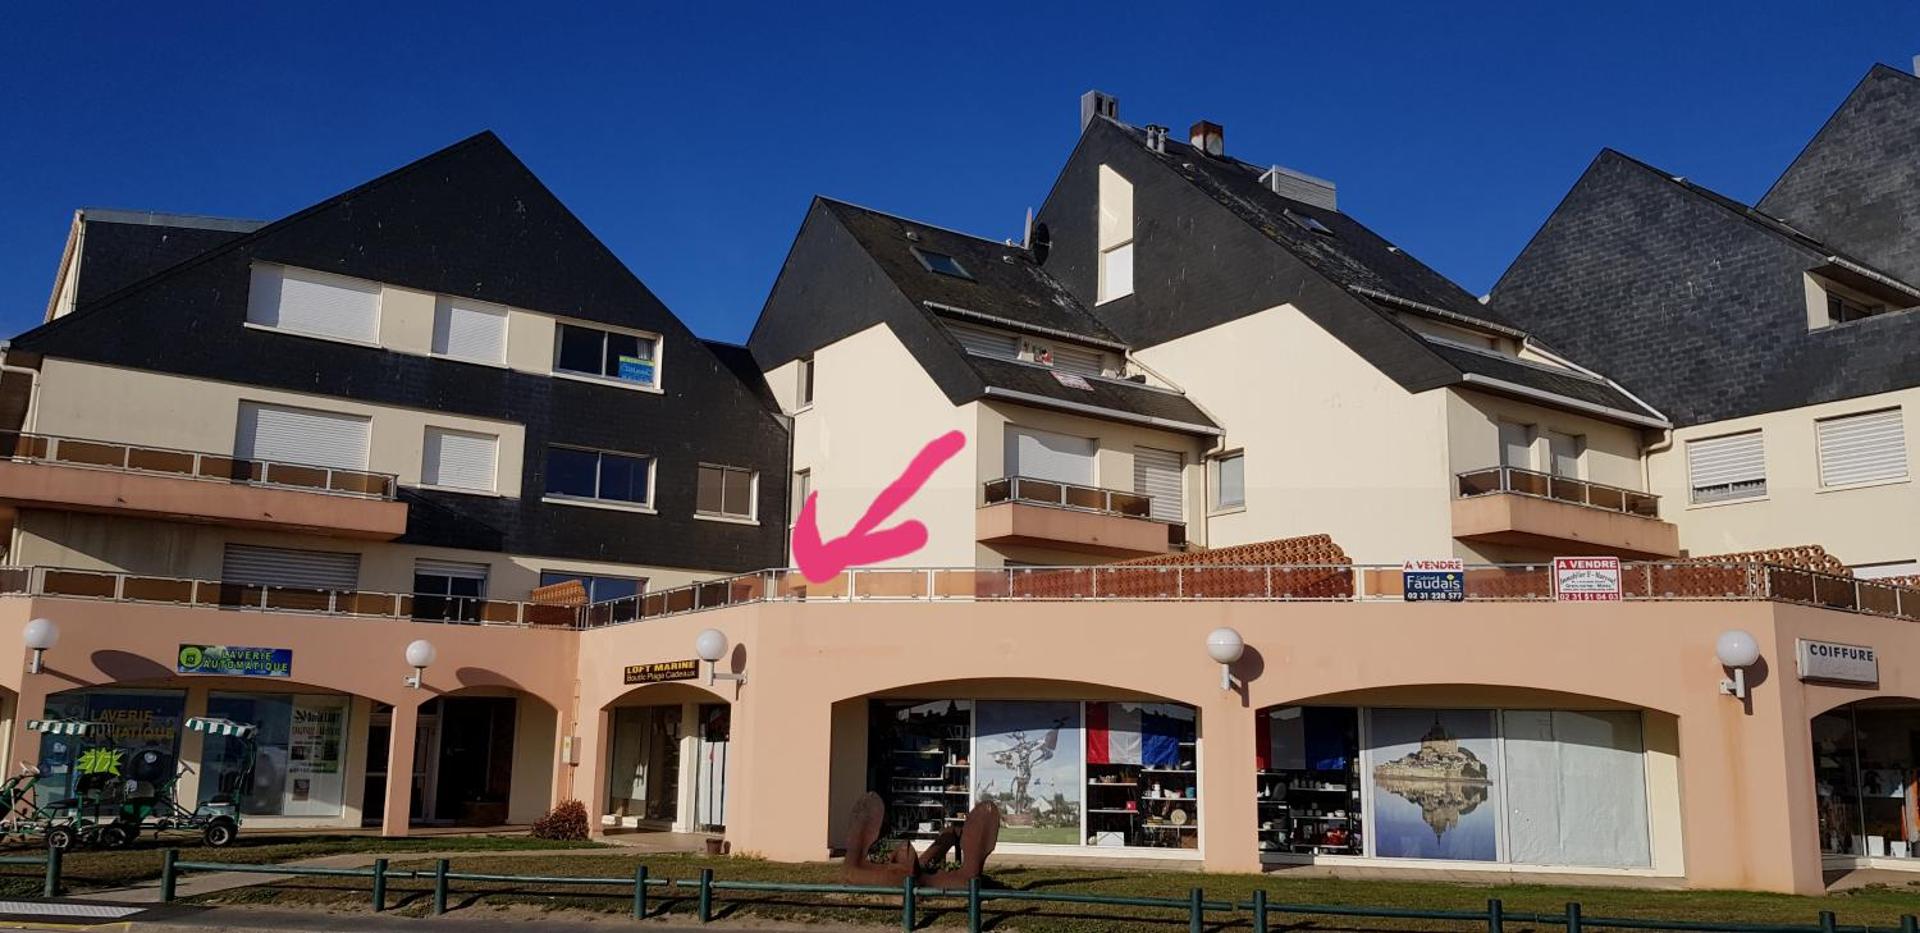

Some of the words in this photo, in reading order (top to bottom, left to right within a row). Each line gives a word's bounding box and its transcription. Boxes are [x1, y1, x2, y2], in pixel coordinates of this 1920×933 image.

[1404, 560, 1413, 570] A
[1416, 560, 1462, 570] VENDRE
[1558, 560, 1567, 569] A
[1569, 560, 1617, 569] VENDRE
[1407, 575, 1461, 590] Faudais
[1407, 592, 1418, 600] 02
[1419, 592, 1429, 600] 31
[1430, 592, 1446, 600] 228
[1448, 592, 1463, 600] 577
[221, 649, 273, 661] LAVERIE
[1809, 644, 1874, 662] COIFFURE
[203, 659, 289, 672] AUTOMATIQUE
[627, 665, 650, 674] LOFT
[654, 661, 695, 672] MARINE
[91, 708, 154, 723] LAVERIE
